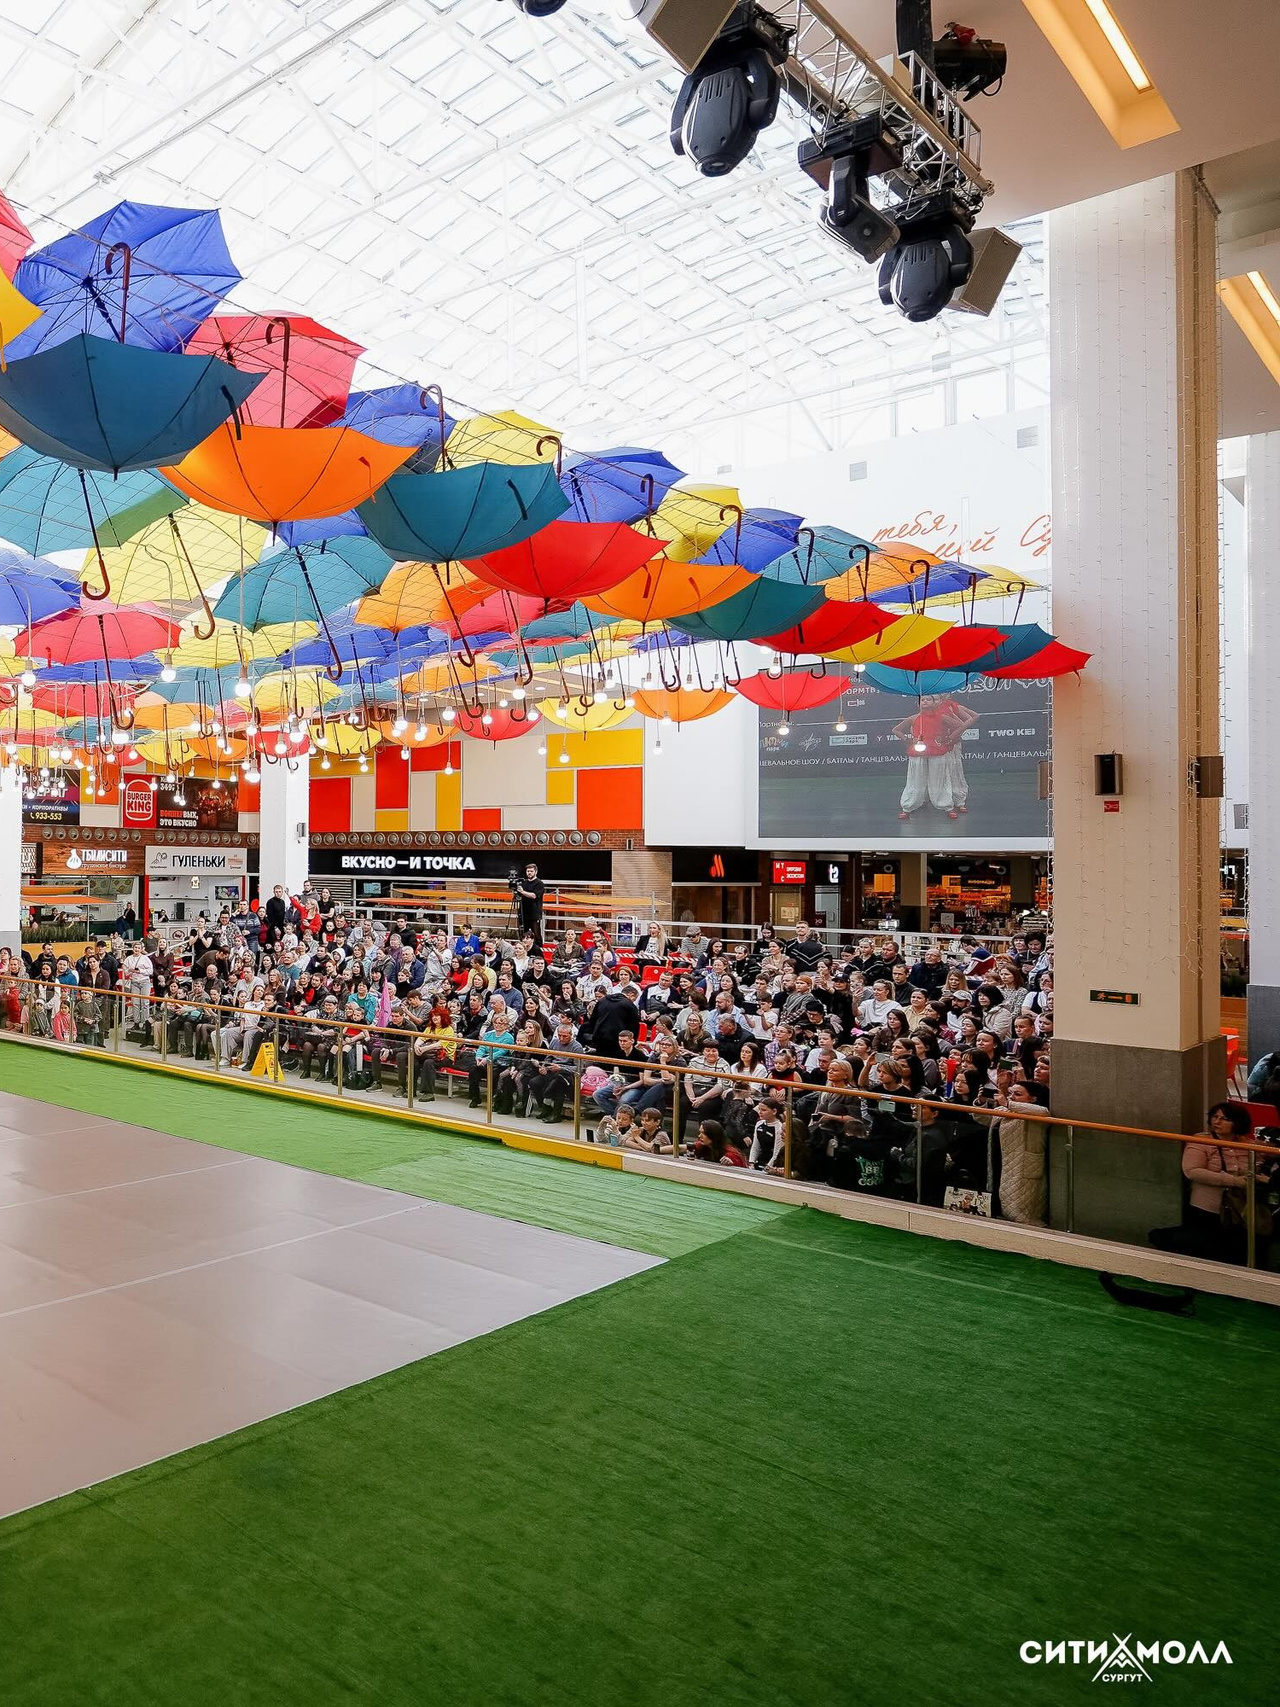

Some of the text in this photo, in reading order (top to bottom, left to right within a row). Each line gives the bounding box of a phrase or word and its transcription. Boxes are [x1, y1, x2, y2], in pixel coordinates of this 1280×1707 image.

[988, 729, 1015, 737] TWO
[127, 792, 152, 801] BURGER
[127, 802, 152, 812] KING
[35, 812, 62, 820] 933-553
[81, 849, 127, 862] ТБИЛИСИТИ
[172, 855, 226, 868] ГУЛЕНЬКИ
[341, 855, 396, 869] ВКУСНО
[423, 856, 476, 870] ТОЧКА
